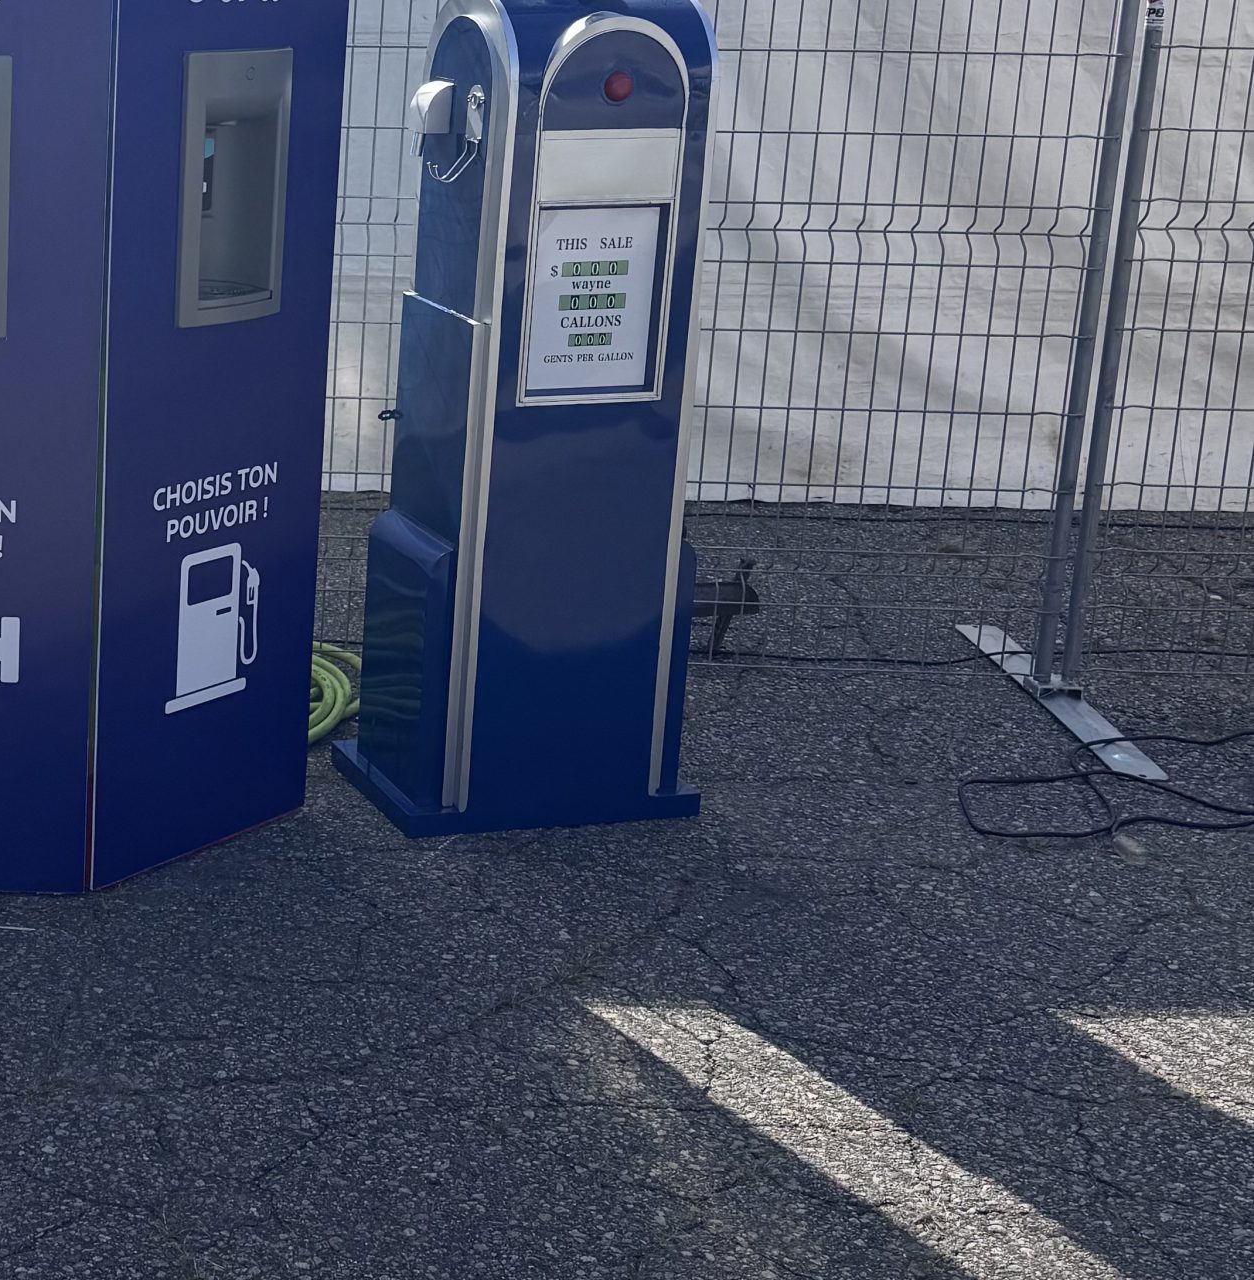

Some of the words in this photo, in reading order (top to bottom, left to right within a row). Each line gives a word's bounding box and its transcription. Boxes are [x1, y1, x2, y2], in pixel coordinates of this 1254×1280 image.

[556, 237, 588, 251] THIS
[600, 236, 633, 249] SALE
[550, 265, 559, 278] $
[571, 279, 611, 292] wayne
[577, 353, 594, 362] PER
[597, 352, 634, 362] GALLON
[153, 472, 233, 511] CHOISIS
[237, 461, 279, 490] TON
[165, 502, 259, 543] POUVOIR
[262, 496, 270, 519] !
